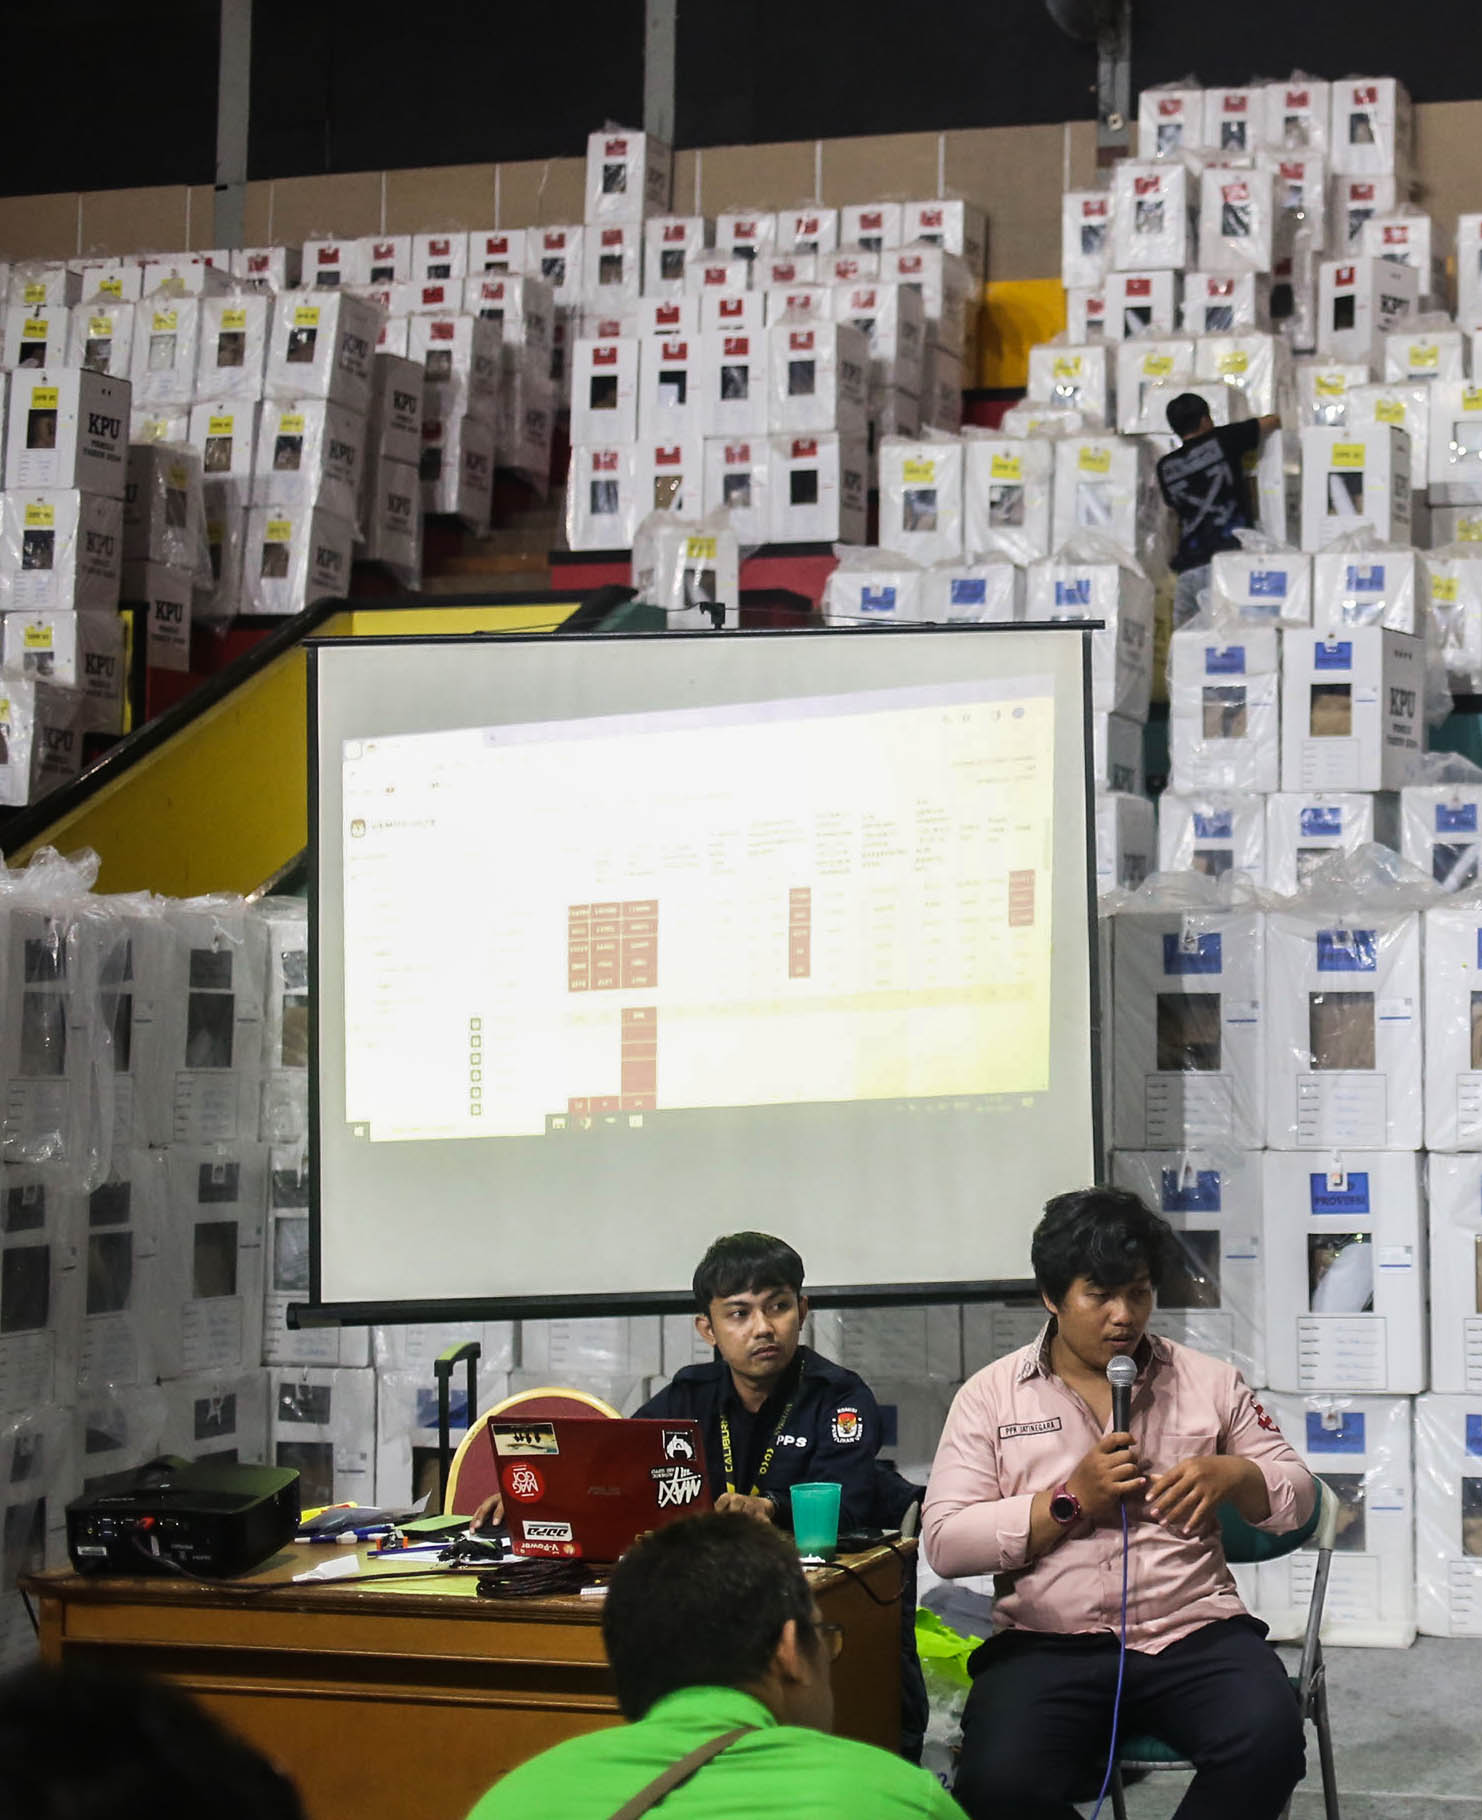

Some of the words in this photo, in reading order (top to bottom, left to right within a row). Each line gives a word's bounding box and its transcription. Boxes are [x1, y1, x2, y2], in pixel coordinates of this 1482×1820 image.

[88, 413, 121, 440] KPU
[155, 600, 183, 625] KPU
[85, 654, 116, 678] KPU
[1389, 687, 1417, 719] KPU
[1005, 1426, 1018, 1436] PPK
[1019, 1421, 1056, 1434] JATINEGARA
[776, 1435, 808, 1448] PPS
